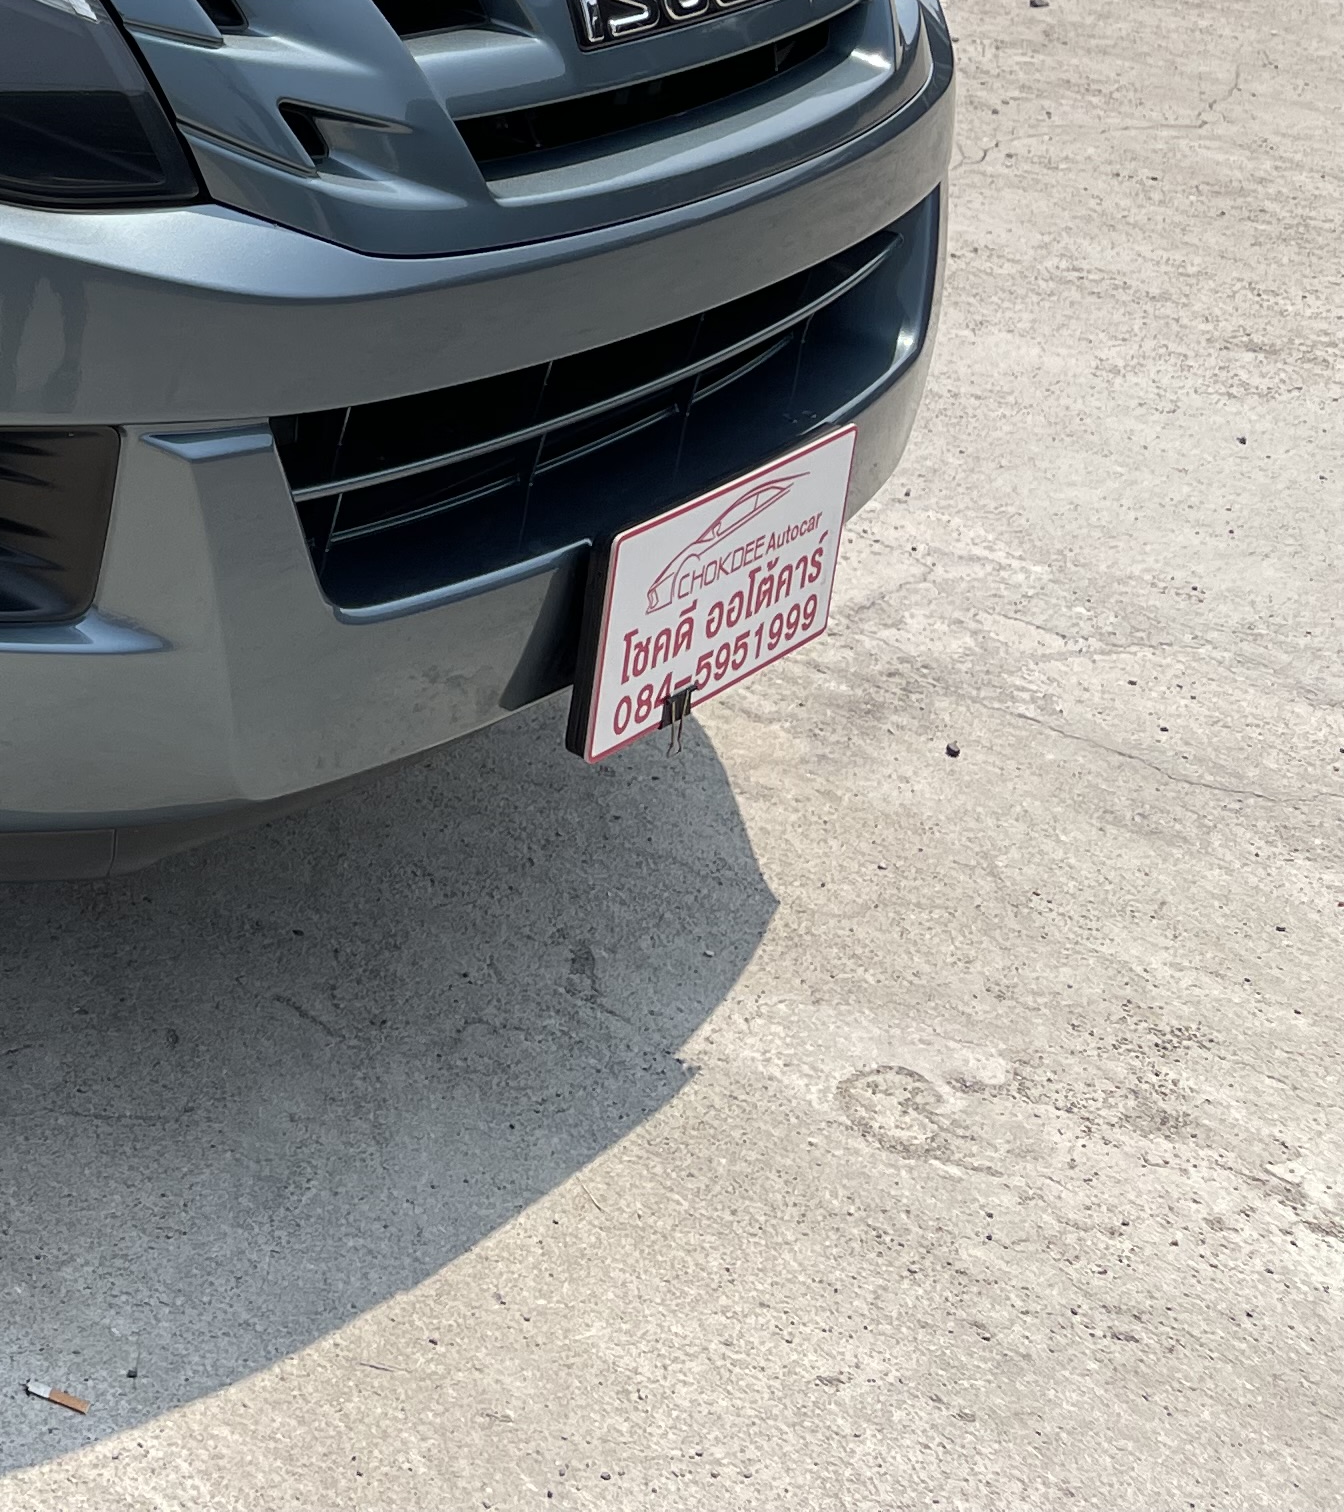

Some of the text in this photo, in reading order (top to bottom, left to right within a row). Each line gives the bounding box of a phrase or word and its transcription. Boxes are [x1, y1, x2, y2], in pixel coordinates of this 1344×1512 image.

[621, 529, 829, 685] โชคดี ออโต้คาร์
[677, 511, 823, 600] CHOKDEE Autocar
[613, 593, 818, 736] 084-5951999
